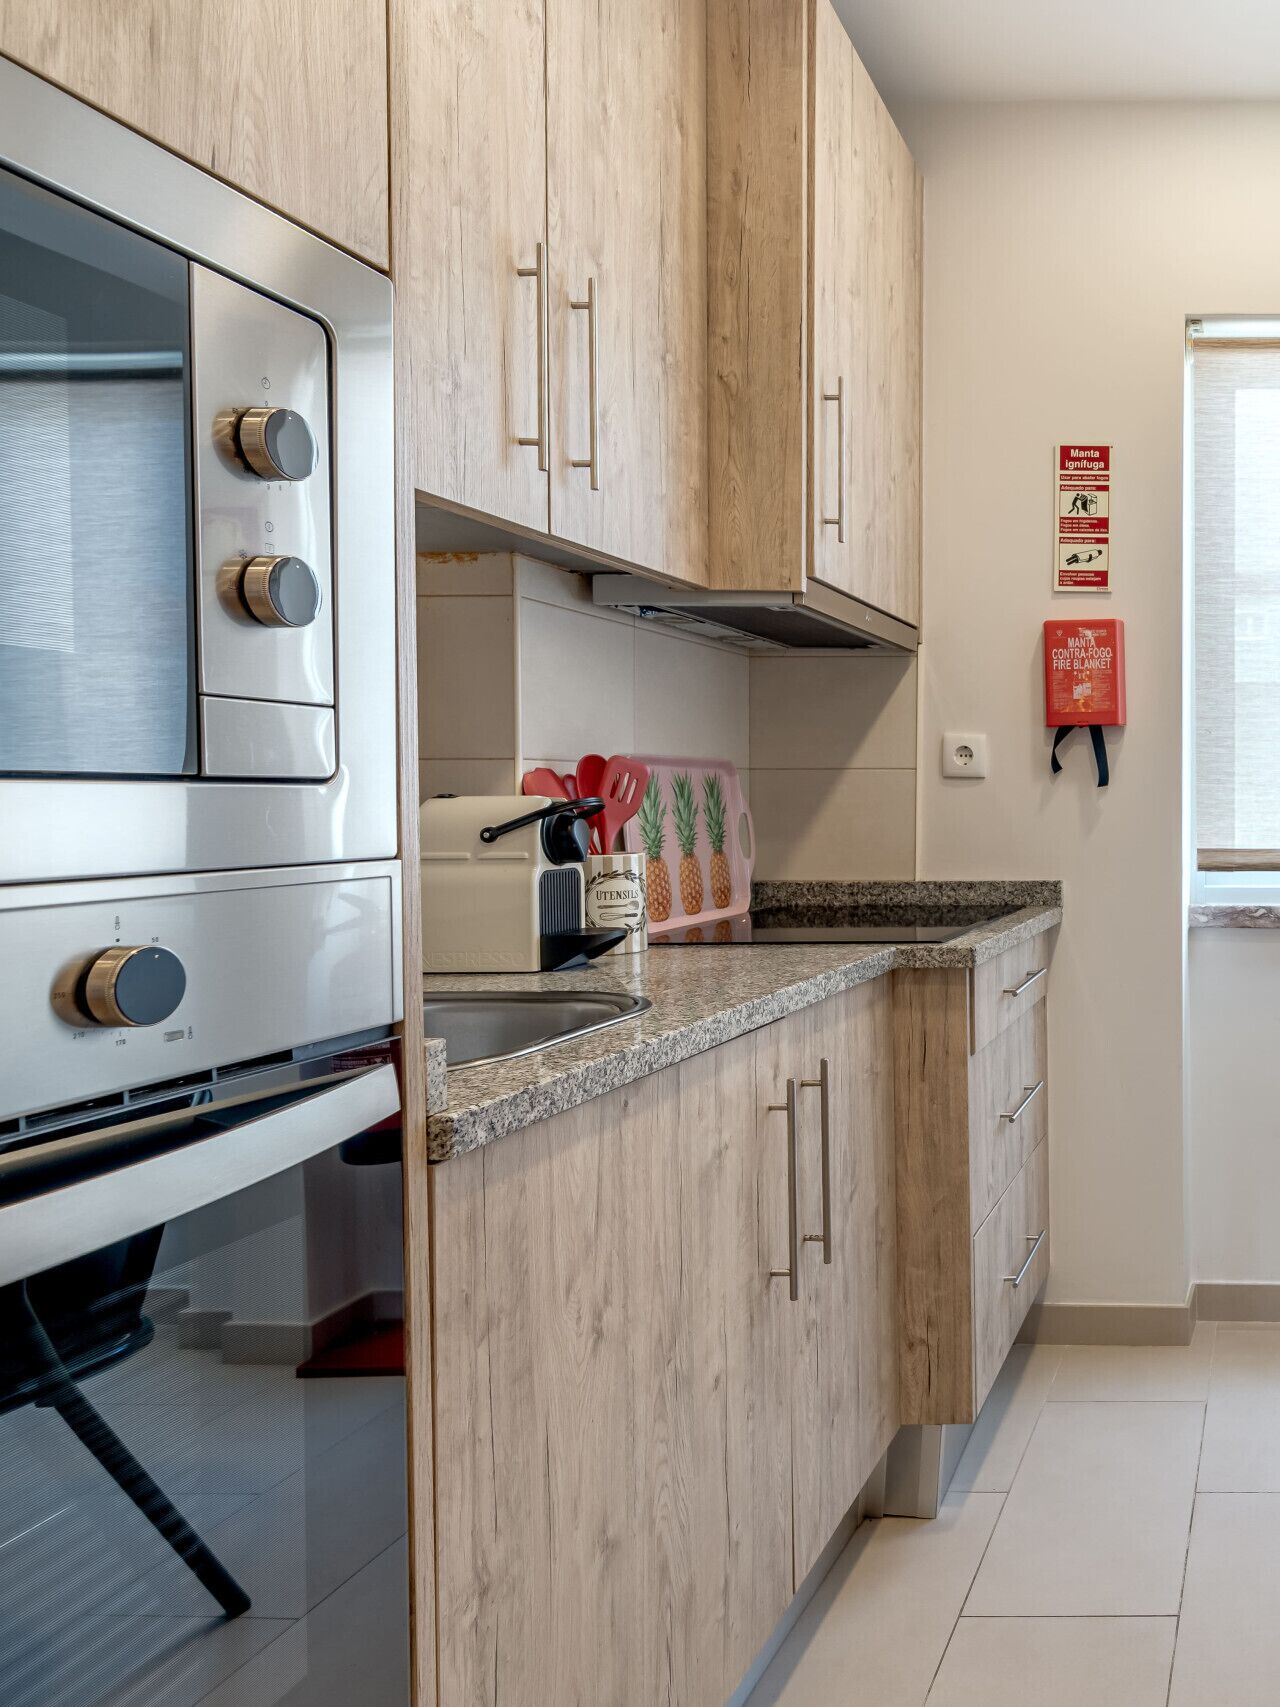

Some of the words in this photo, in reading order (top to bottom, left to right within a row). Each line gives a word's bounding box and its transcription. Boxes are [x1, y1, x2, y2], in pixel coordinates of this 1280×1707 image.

[1070, 449, 1100, 458] Manta
[1065, 459, 1105, 470] ignífuga
[1067, 637, 1096, 648] MANTA
[1052, 647, 1112, 659] CONTRA-FOGO
[1053, 659, 1072, 670] FIRE
[1073, 658, 1112, 669] BLANKET
[596, 889, 639, 901] UTENSILS
